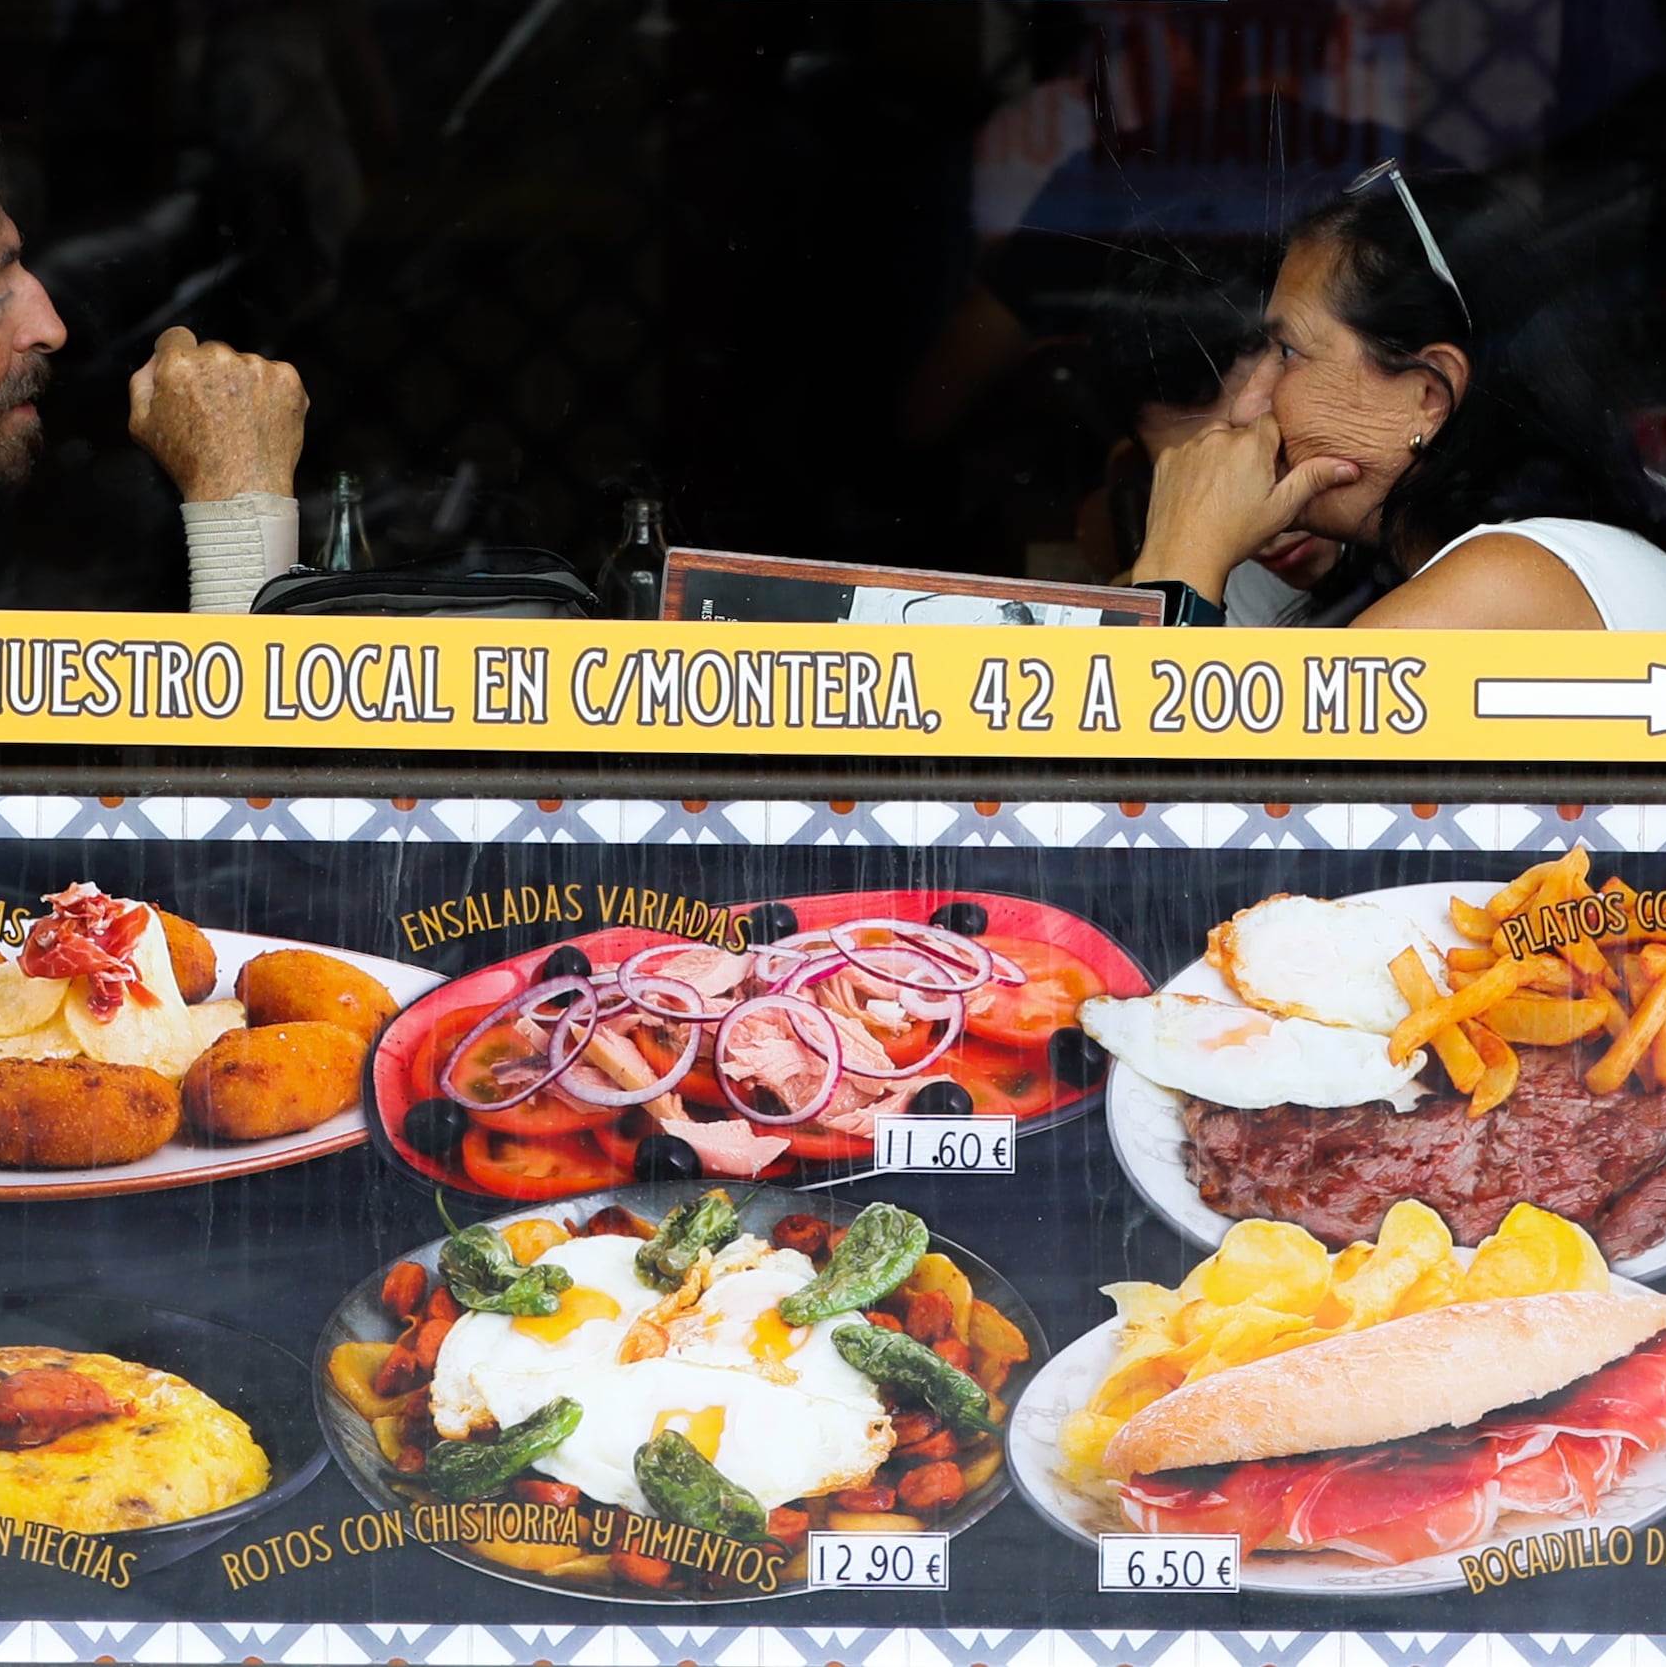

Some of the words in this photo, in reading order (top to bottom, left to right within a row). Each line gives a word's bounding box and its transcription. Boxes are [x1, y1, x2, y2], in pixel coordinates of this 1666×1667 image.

[263, 643, 451, 723] LOCAL
[472, 647, 547, 724] EN
[970, 656, 1053, 730] 42
[1078, 654, 1121, 732] A
[1151, 659, 1282, 734] 200
[1303, 655, 1427, 734] MTS
[400, 884, 583, 952] ENSALADAS
[597, 883, 753, 955] VARIADAS
[1502, 891, 1627, 961] PLATOS
[23, 1520, 138, 1590] HECHAS
[221, 1524, 333, 1591] ROTOS
[340, 1509, 403, 1557] CON
[414, 1502, 579, 1547] CHISTORRA
[624, 1514, 786, 1592] PIMIENTOS
[1459, 1526, 1634, 1596] BOCADILLO
